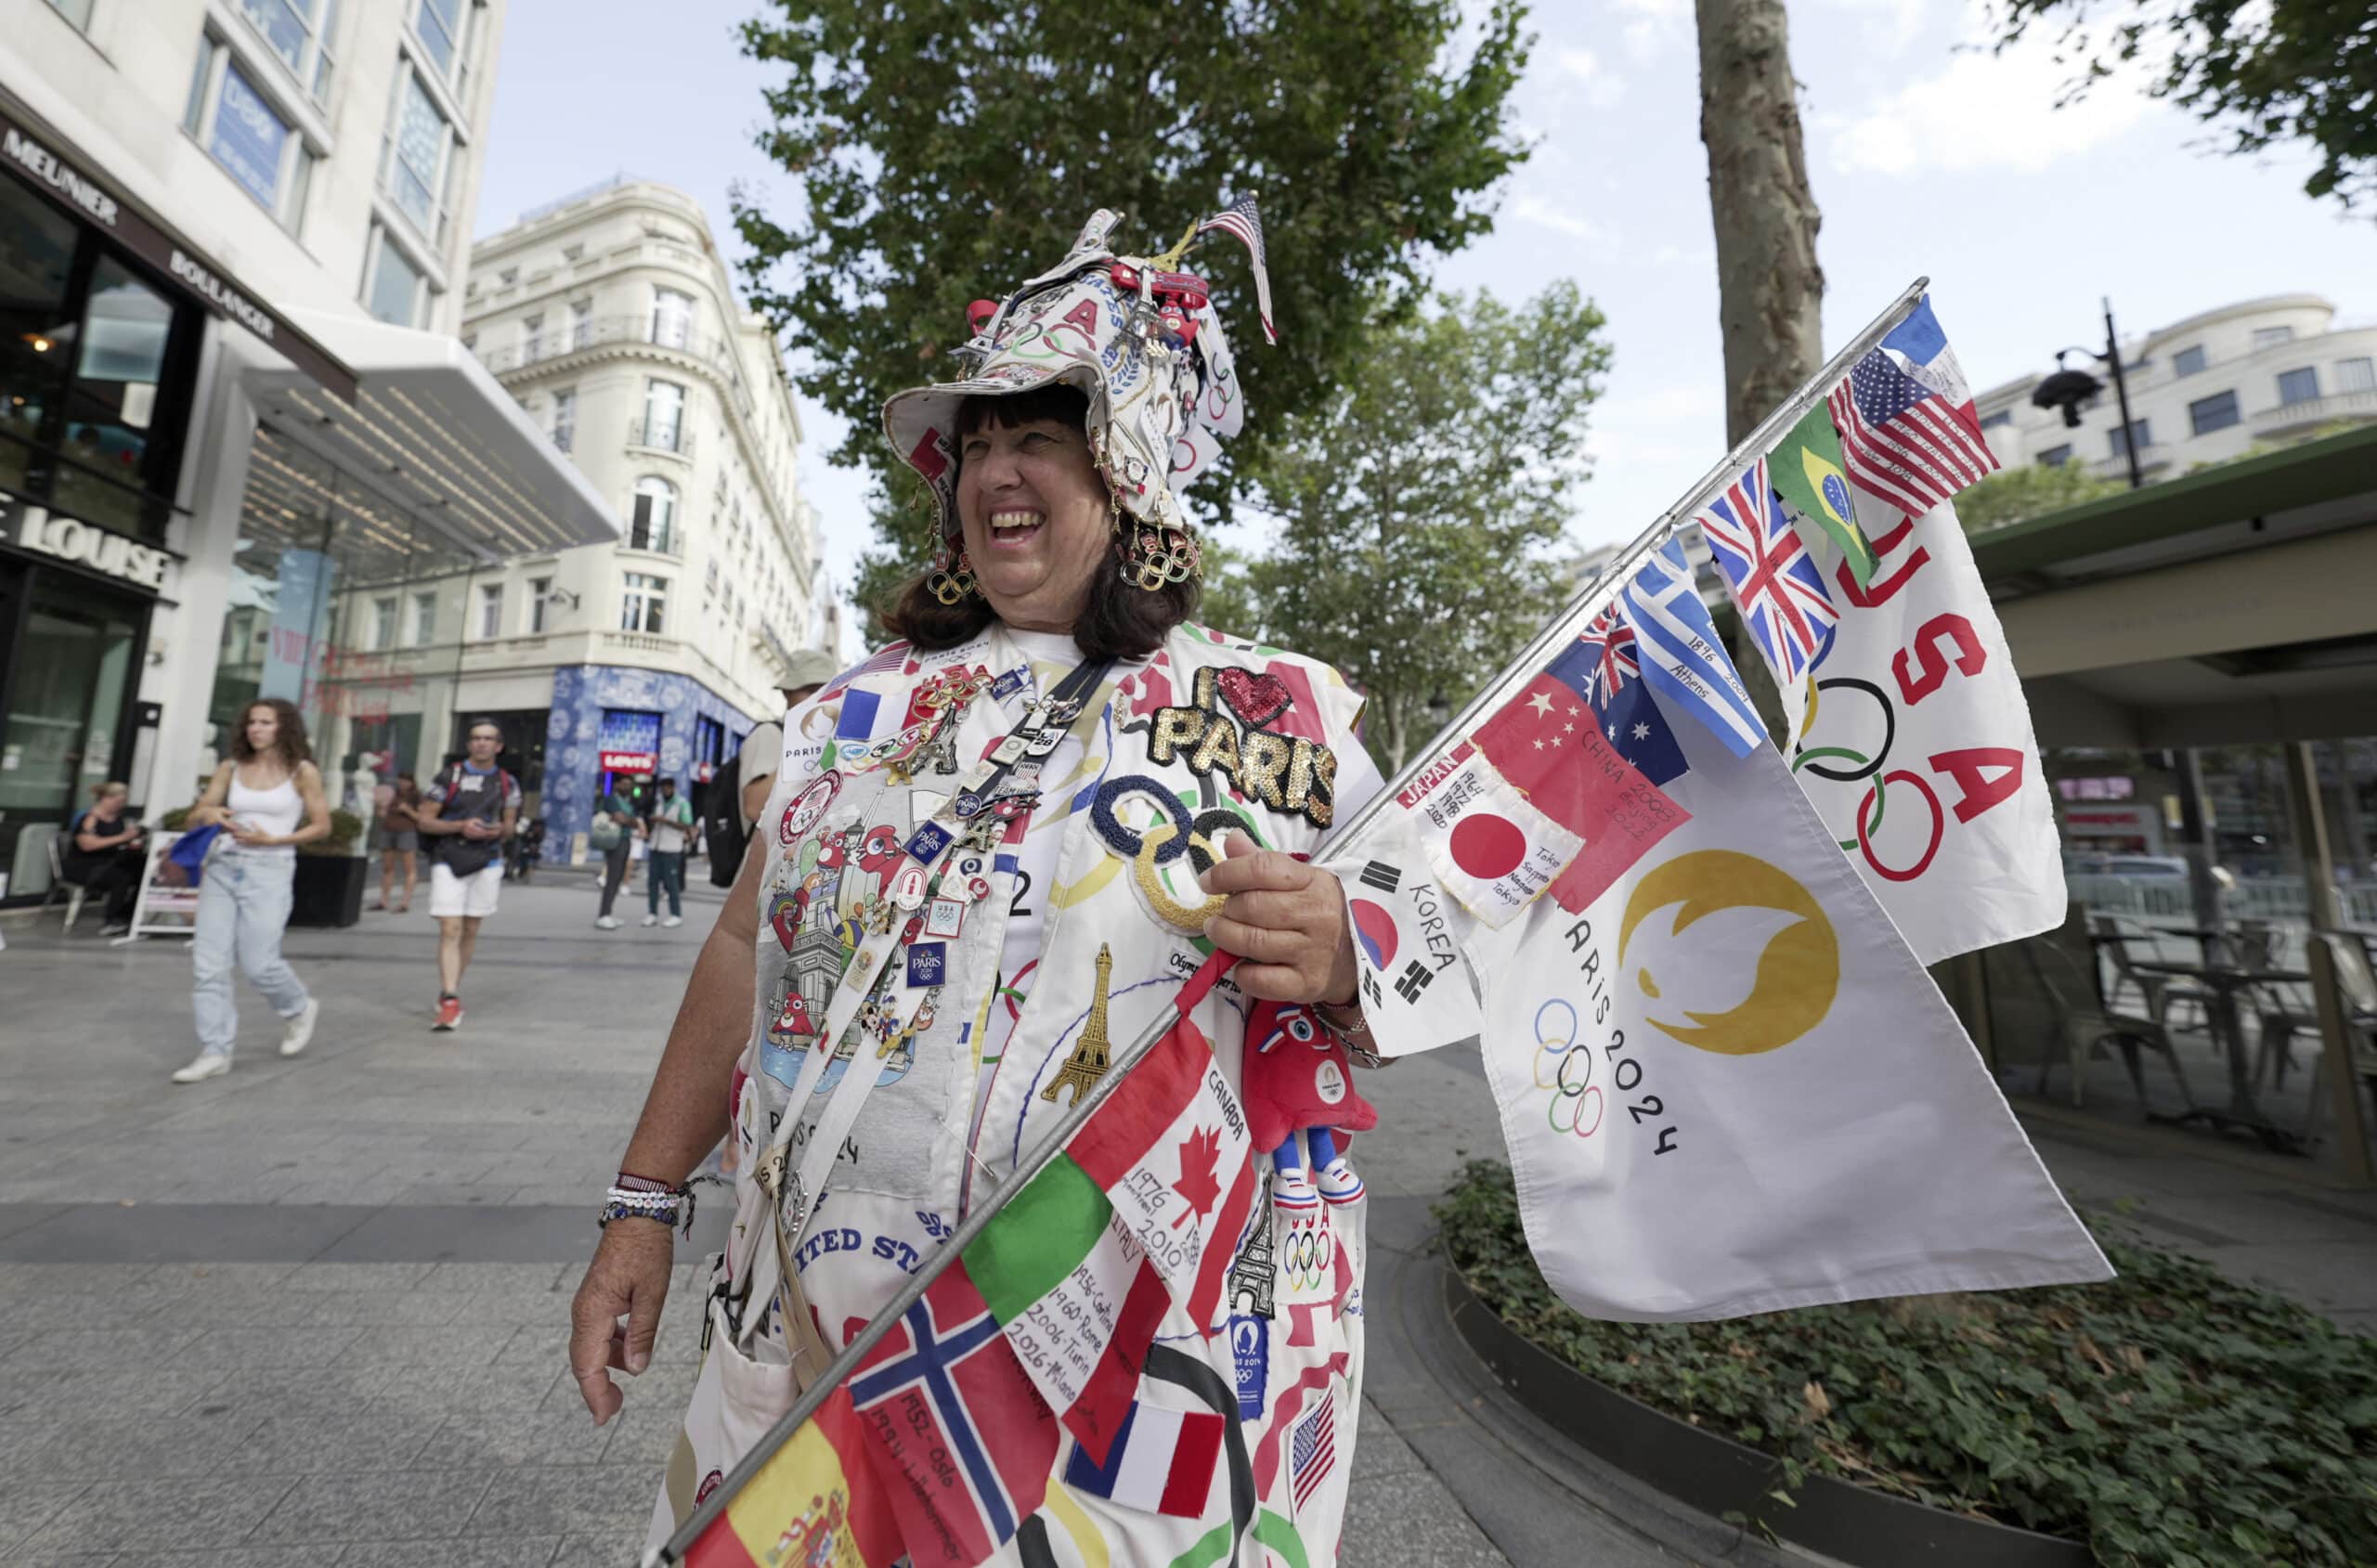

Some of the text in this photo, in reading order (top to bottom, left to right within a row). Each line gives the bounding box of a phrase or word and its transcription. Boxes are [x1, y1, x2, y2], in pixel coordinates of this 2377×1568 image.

[3, 129, 119, 227] MEUNIER
[170, 250, 276, 339] BOULANGER
[19, 507, 171, 589] LOUISE
[1688, 635, 1717, 662] 1896
[1670, 663, 1709, 700] Athens
[786, 745, 822, 758] PARIS
[1150, 706, 1338, 827] PARIS
[1581, 730, 1625, 784] CHINA
[1406, 757, 1459, 806] JAPAN
[917, 829, 942, 852] PARIS
[1409, 882, 1457, 972] KOREA
[913, 956, 942, 969] PARIS
[1208, 1069, 1245, 1142] CANADA
[1604, 1029, 1679, 1156] 2024
[1131, 1168, 1172, 1209] 1976
[1111, 1214, 1139, 1263] ITALY
[1137, 1219, 1182, 1267] 2010
[901, 1393, 923, 1438] 1952
[929, 1447, 955, 1489] Oslo
